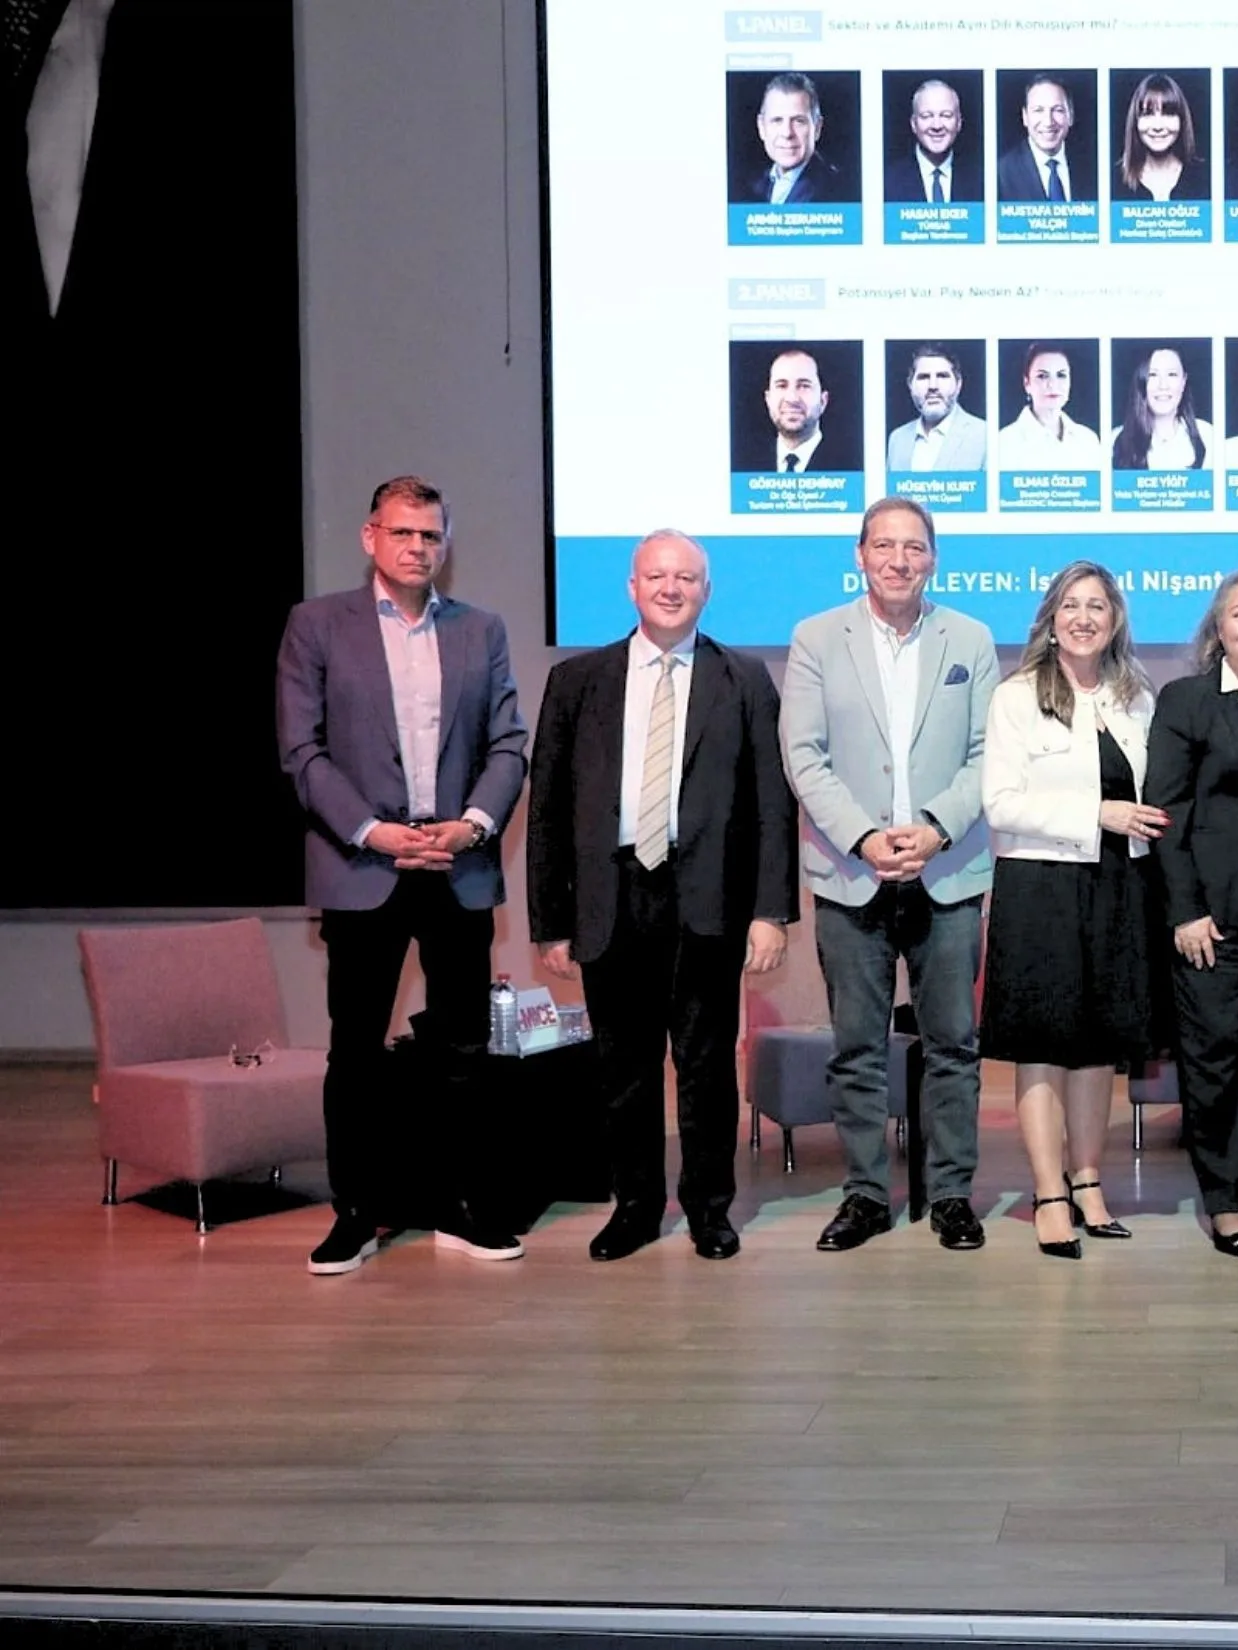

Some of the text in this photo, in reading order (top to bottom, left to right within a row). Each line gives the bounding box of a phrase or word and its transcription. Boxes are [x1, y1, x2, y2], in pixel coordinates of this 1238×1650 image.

[900, 208, 938, 220] HASAN
[1000, 204, 1052, 217] MUSTAFA
[1167, 203, 1200, 218] OĞUZ
[843, 572, 1021, 593] DLEYEN:
[1143, 570, 1224, 596] Nişant
